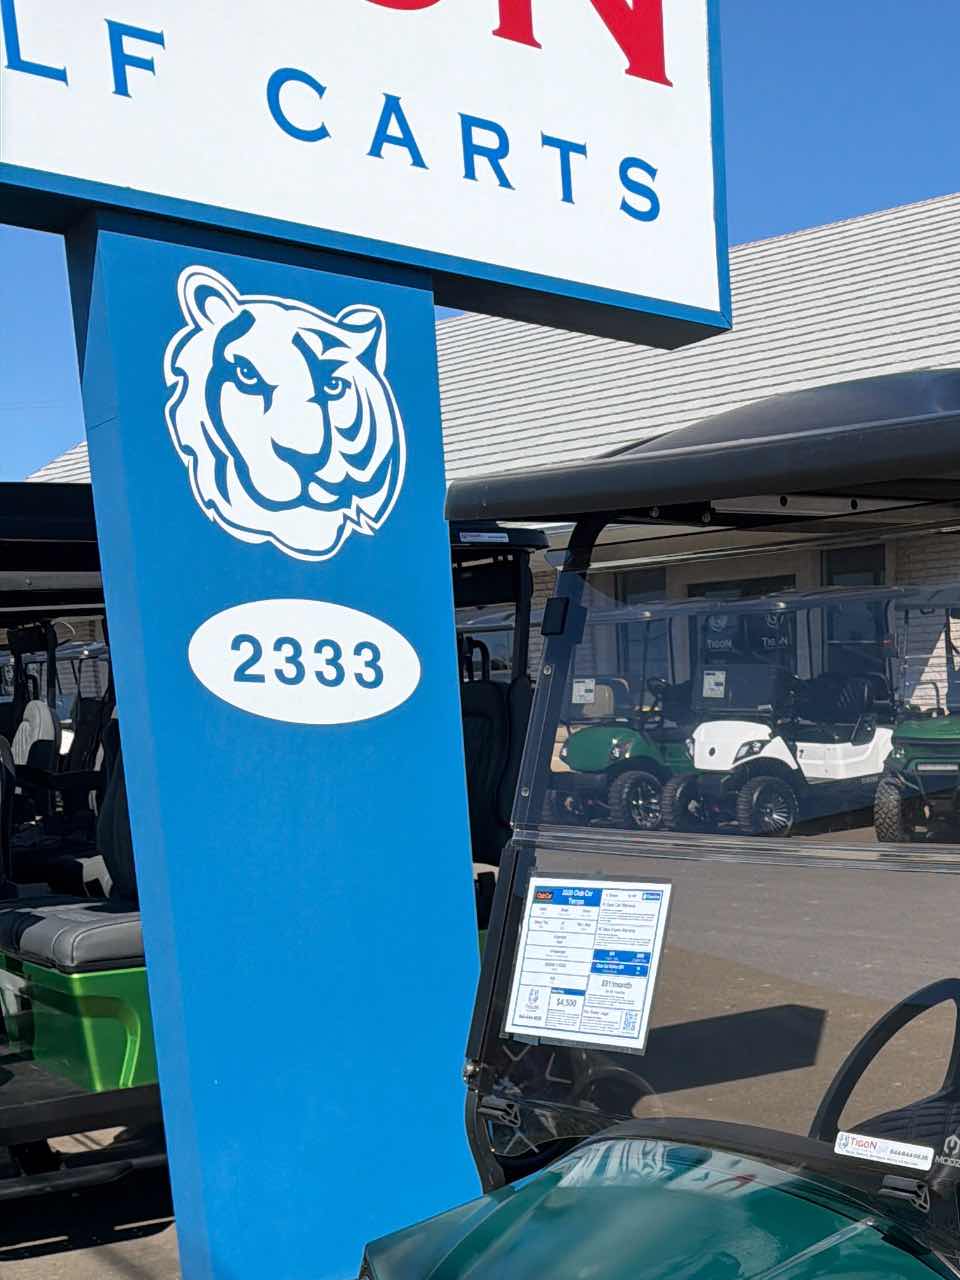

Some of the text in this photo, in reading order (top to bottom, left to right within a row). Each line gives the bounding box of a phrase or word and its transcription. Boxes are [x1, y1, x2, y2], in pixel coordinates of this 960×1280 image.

[266, 67, 661, 222] CARTS
[230, 633, 385, 690] 2333
[848, 1136, 878, 1151] TIGON
